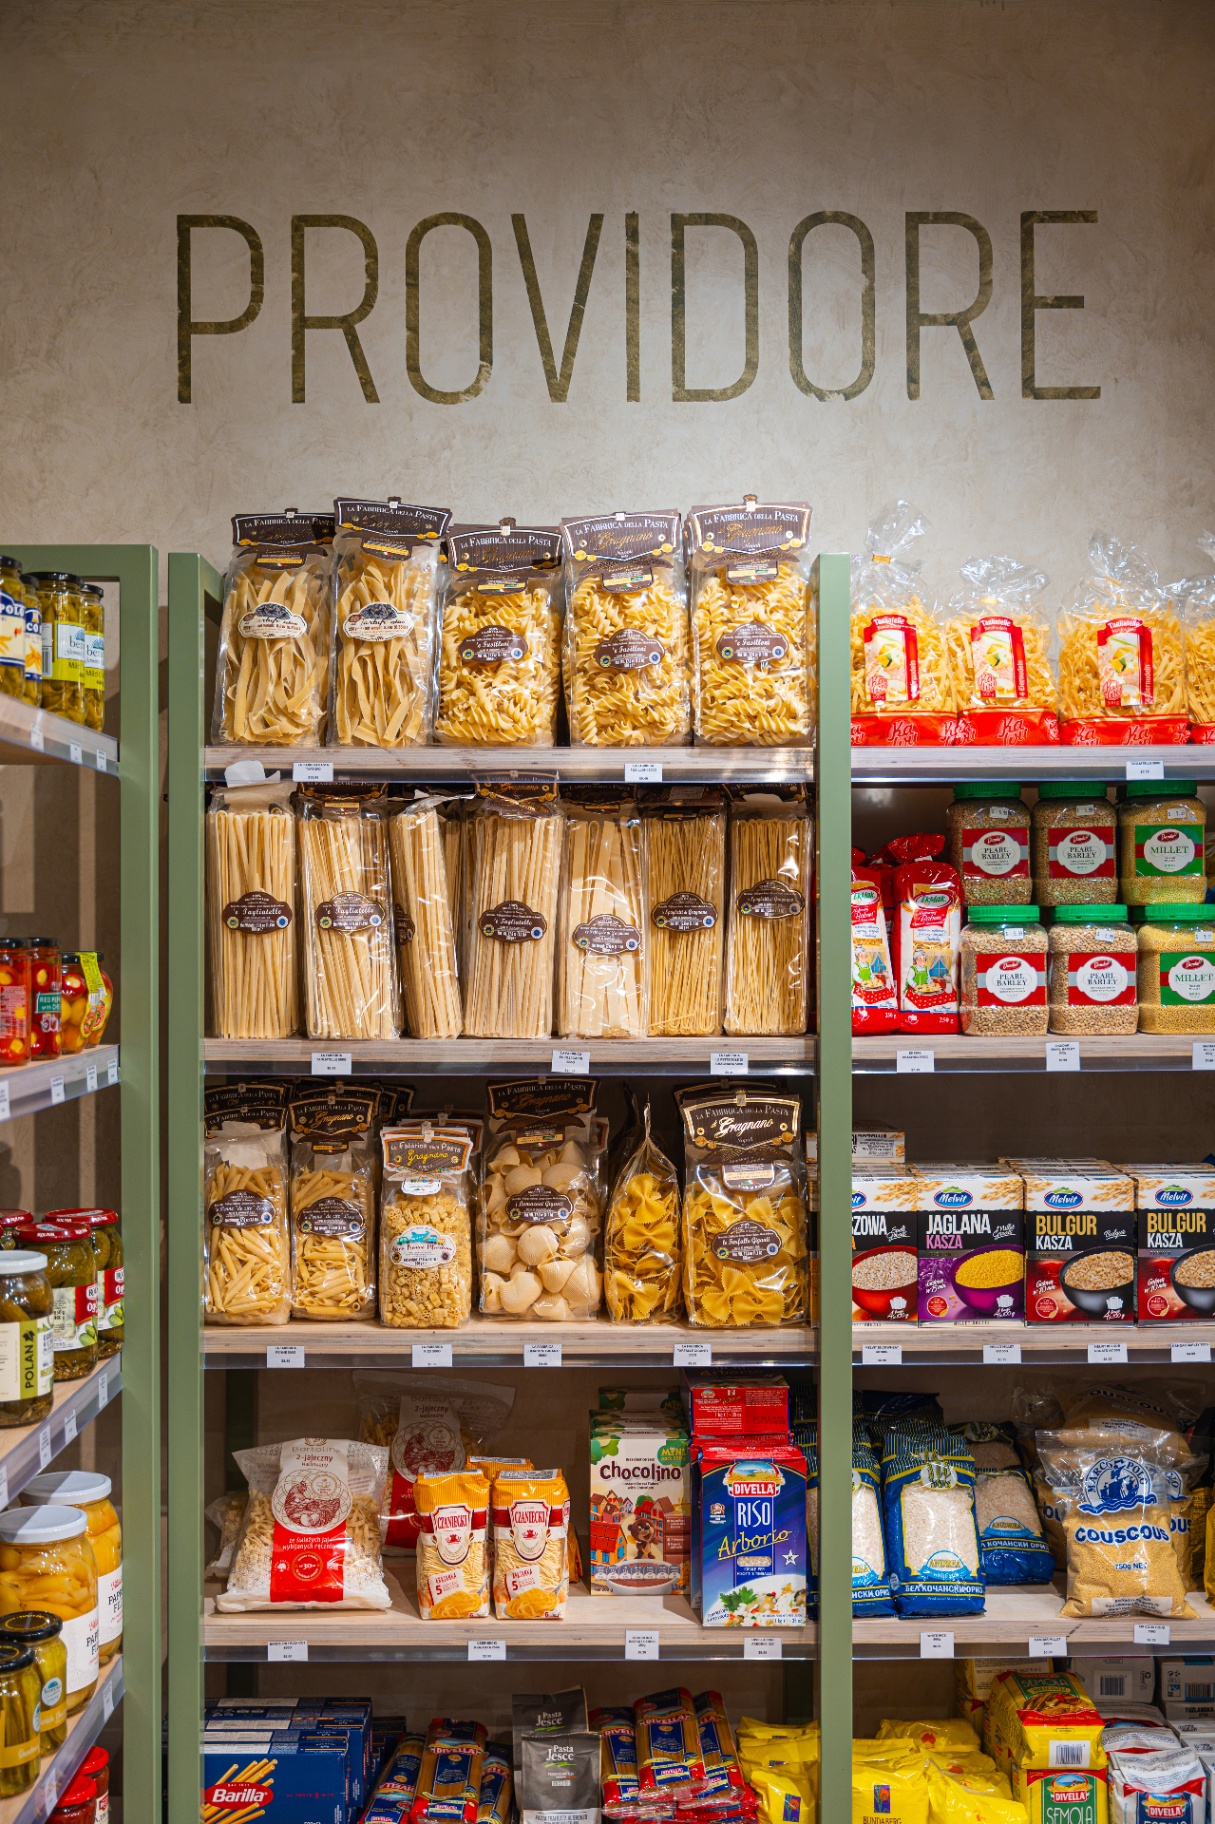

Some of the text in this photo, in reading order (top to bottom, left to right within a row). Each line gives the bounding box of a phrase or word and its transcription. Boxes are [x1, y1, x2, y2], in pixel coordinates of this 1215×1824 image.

[177, 210, 1101, 404] PROVIDORE
[714, 512, 752, 524] FABBRICA
[774, 510, 798, 522] PASTA
[583, 522, 622, 534] FABBRICA
[644, 519, 669, 530] PASTA
[469, 536, 507, 547] FABBRICA
[528, 535, 552, 547] PASTA
[873, 616, 905, 626] Tagliatelle
[981, 618, 1011, 626] Tagliatelle
[1107, 618, 1140, 628] Tagliatelle
[1150, 846, 1189, 854] MILLET
[982, 852, 1011, 860] BARLEY
[1067, 852, 1097, 860] BARLEY
[243, 908, 282, 916] Tagliatelle
[336, 908, 374, 916] Tagliatelle
[500, 918, 532, 926] Tagliatelle
[1175, 974, 1214, 982] MILLET
[506, 1085, 542, 1095] FABBRICA
[564, 1082, 587, 1092] PASTA
[704, 1106, 743, 1117] FABBRICA
[764, 1105, 789, 1116] PASTA
[714, 1116, 774, 1138] Gragnano
[408, 1149, 448, 1166] Gragnano
[939, 1194, 967, 1204] Melvit
[1048, 1194, 1078, 1204] Melvit
[1160, 1193, 1188, 1202] Melvit
[926, 1214, 992, 1235] JAGLANA
[1036, 1214, 1097, 1236] BULGUR
[1147, 1212, 1206, 1233] BULGUR
[750, 1236, 770, 1245] Giganti
[926, 1234, 963, 1250] KASZA
[1036, 1236, 1073, 1250] KASZA
[1147, 1232, 1184, 1248] KASZA
[25, 1344, 34, 1389] POLAN
[414, 1405, 448, 1414] 2-jajeczny
[662, 1448, 686, 1456] MINI
[296, 1454, 334, 1462] 2-jajeczny
[1088, 1461, 1113, 1493] MARCO
[1126, 1462, 1148, 1486] POLO
[734, 1484, 774, 1494] DIVELLA
[514, 1510, 545, 1524] CZANIECKI
[738, 1500, 771, 1528] RISO
[438, 1514, 468, 1529] CZANIECKI
[1075, 1526, 1170, 1544] COUSCOUS
[718, 1530, 793, 1558] Arborio
[1114, 1562, 1132, 1570] 750g
[436, 1586, 442, 1596] 5
[512, 1581, 518, 1591] 5
[1022, 1678, 1068, 1687] SEMOLA
[536, 1714, 563, 1727] Jesce
[542, 1712, 562, 1720] Pasta
[644, 1714, 684, 1724] DIVELLA
[554, 1744, 574, 1753] Pasta
[546, 1748, 574, 1761] Jesce
[212, 1788, 265, 1802] Barilla
[1054, 1792, 1086, 1800] DIVELLA
[1046, 1806, 1093, 1824] SEMOLA
[1150, 1807, 1182, 1816] DIVELLA
